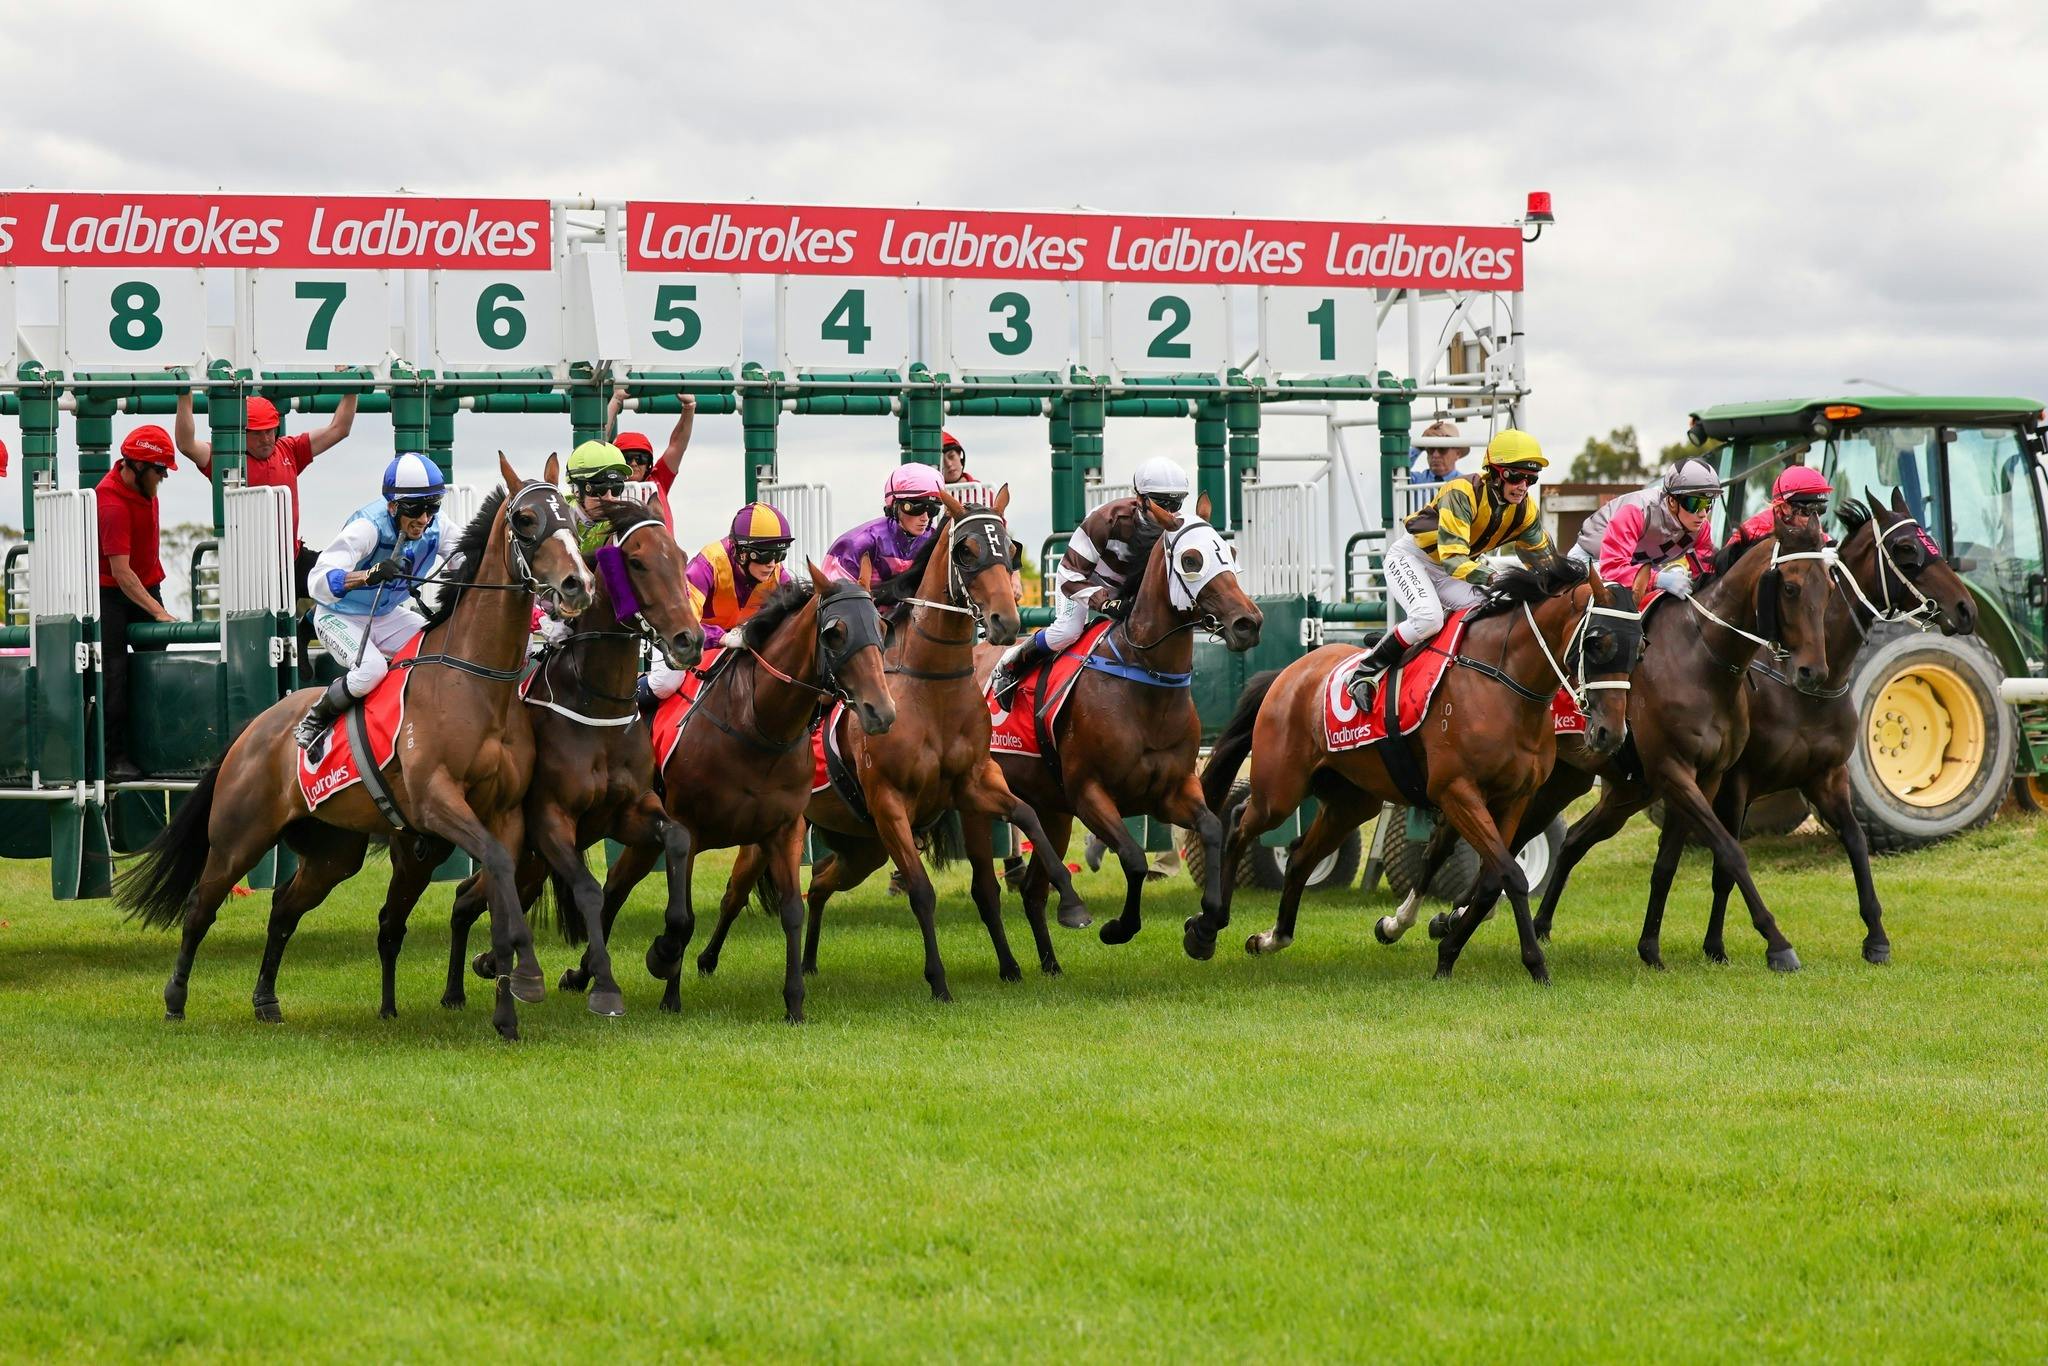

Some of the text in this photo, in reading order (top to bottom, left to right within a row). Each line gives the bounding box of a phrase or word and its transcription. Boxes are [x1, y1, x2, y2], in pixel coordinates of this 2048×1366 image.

[42, 204, 284, 255] Ladbrokes
[308, 207, 540, 257] Ladbrokes
[639, 212, 858, 264] Ladbrokes
[880, 219, 1088, 272] Ladbrokes
[1107, 226, 1306, 275] Ladbrokes
[1325, 231, 1515, 280] Ladbrokes
[109, 281, 163, 351] 8
[295, 281, 347, 351] 7
[476, 283, 527, 350] 6
[651, 284, 702, 351] 5
[821, 288, 872, 354] 4
[988, 291, 1033, 356] 3
[1147, 295, 1192, 359] 2
[1307, 298, 1336, 361] 1
[983, 523, 1003, 558] PHL
